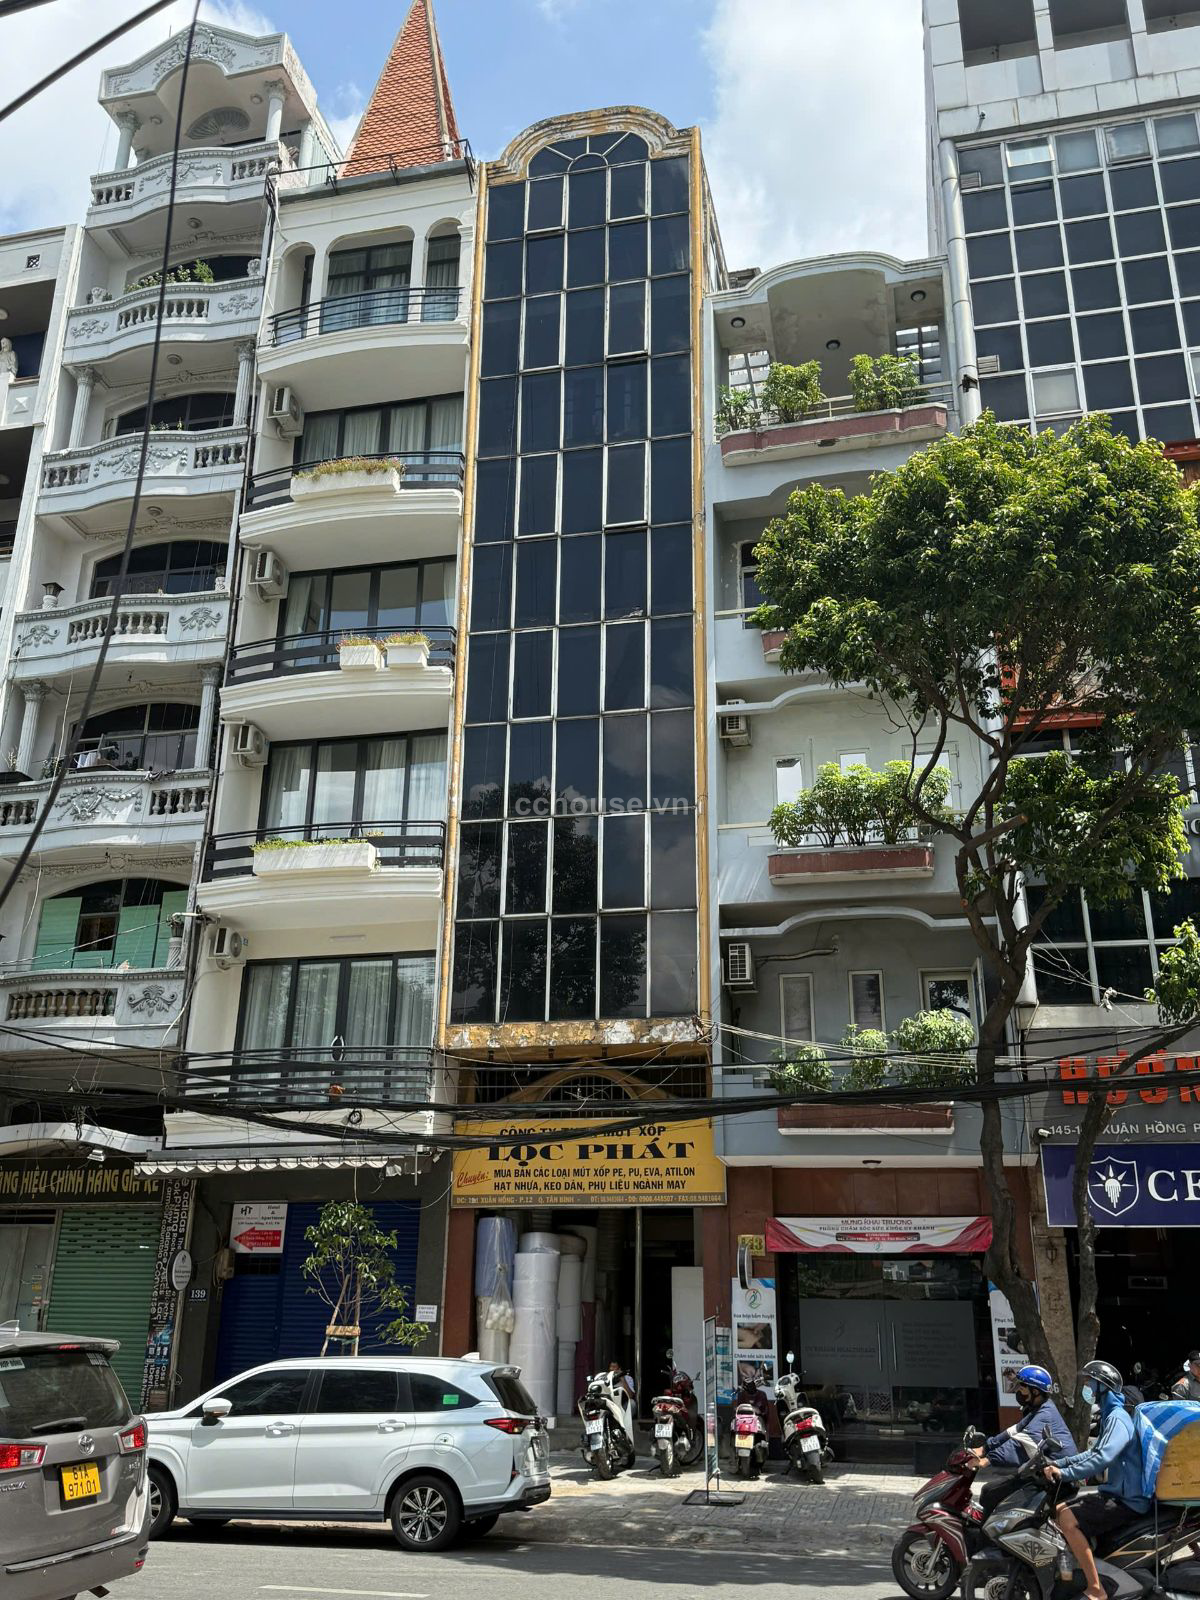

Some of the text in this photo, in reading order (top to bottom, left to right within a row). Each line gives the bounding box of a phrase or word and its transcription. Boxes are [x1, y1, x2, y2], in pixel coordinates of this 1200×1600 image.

[1102, 1122, 1140, 1134] XUÂN
[1145, 1120, 1186, 1134] HỒNG
[487, 1137, 695, 1167] LỌC PHÁT
[494, 1165, 695, 1180] MUA BÁN CÁC LOẠI MÚT XỐP PE, PU, EVA, ATILON
[494, 1179, 686, 1192] HẠT NHỰA, KEO DÁN, PHỤ LIỆU NGÀNH MAY
[178, 1191, 190, 1233] adidas
[150, 1261, 164, 1314] Converse
[190, 1290, 206, 1298] 139
[72, 1464, 90, 1480] 61A
[68, 1480, 97, 1497] 971.01
